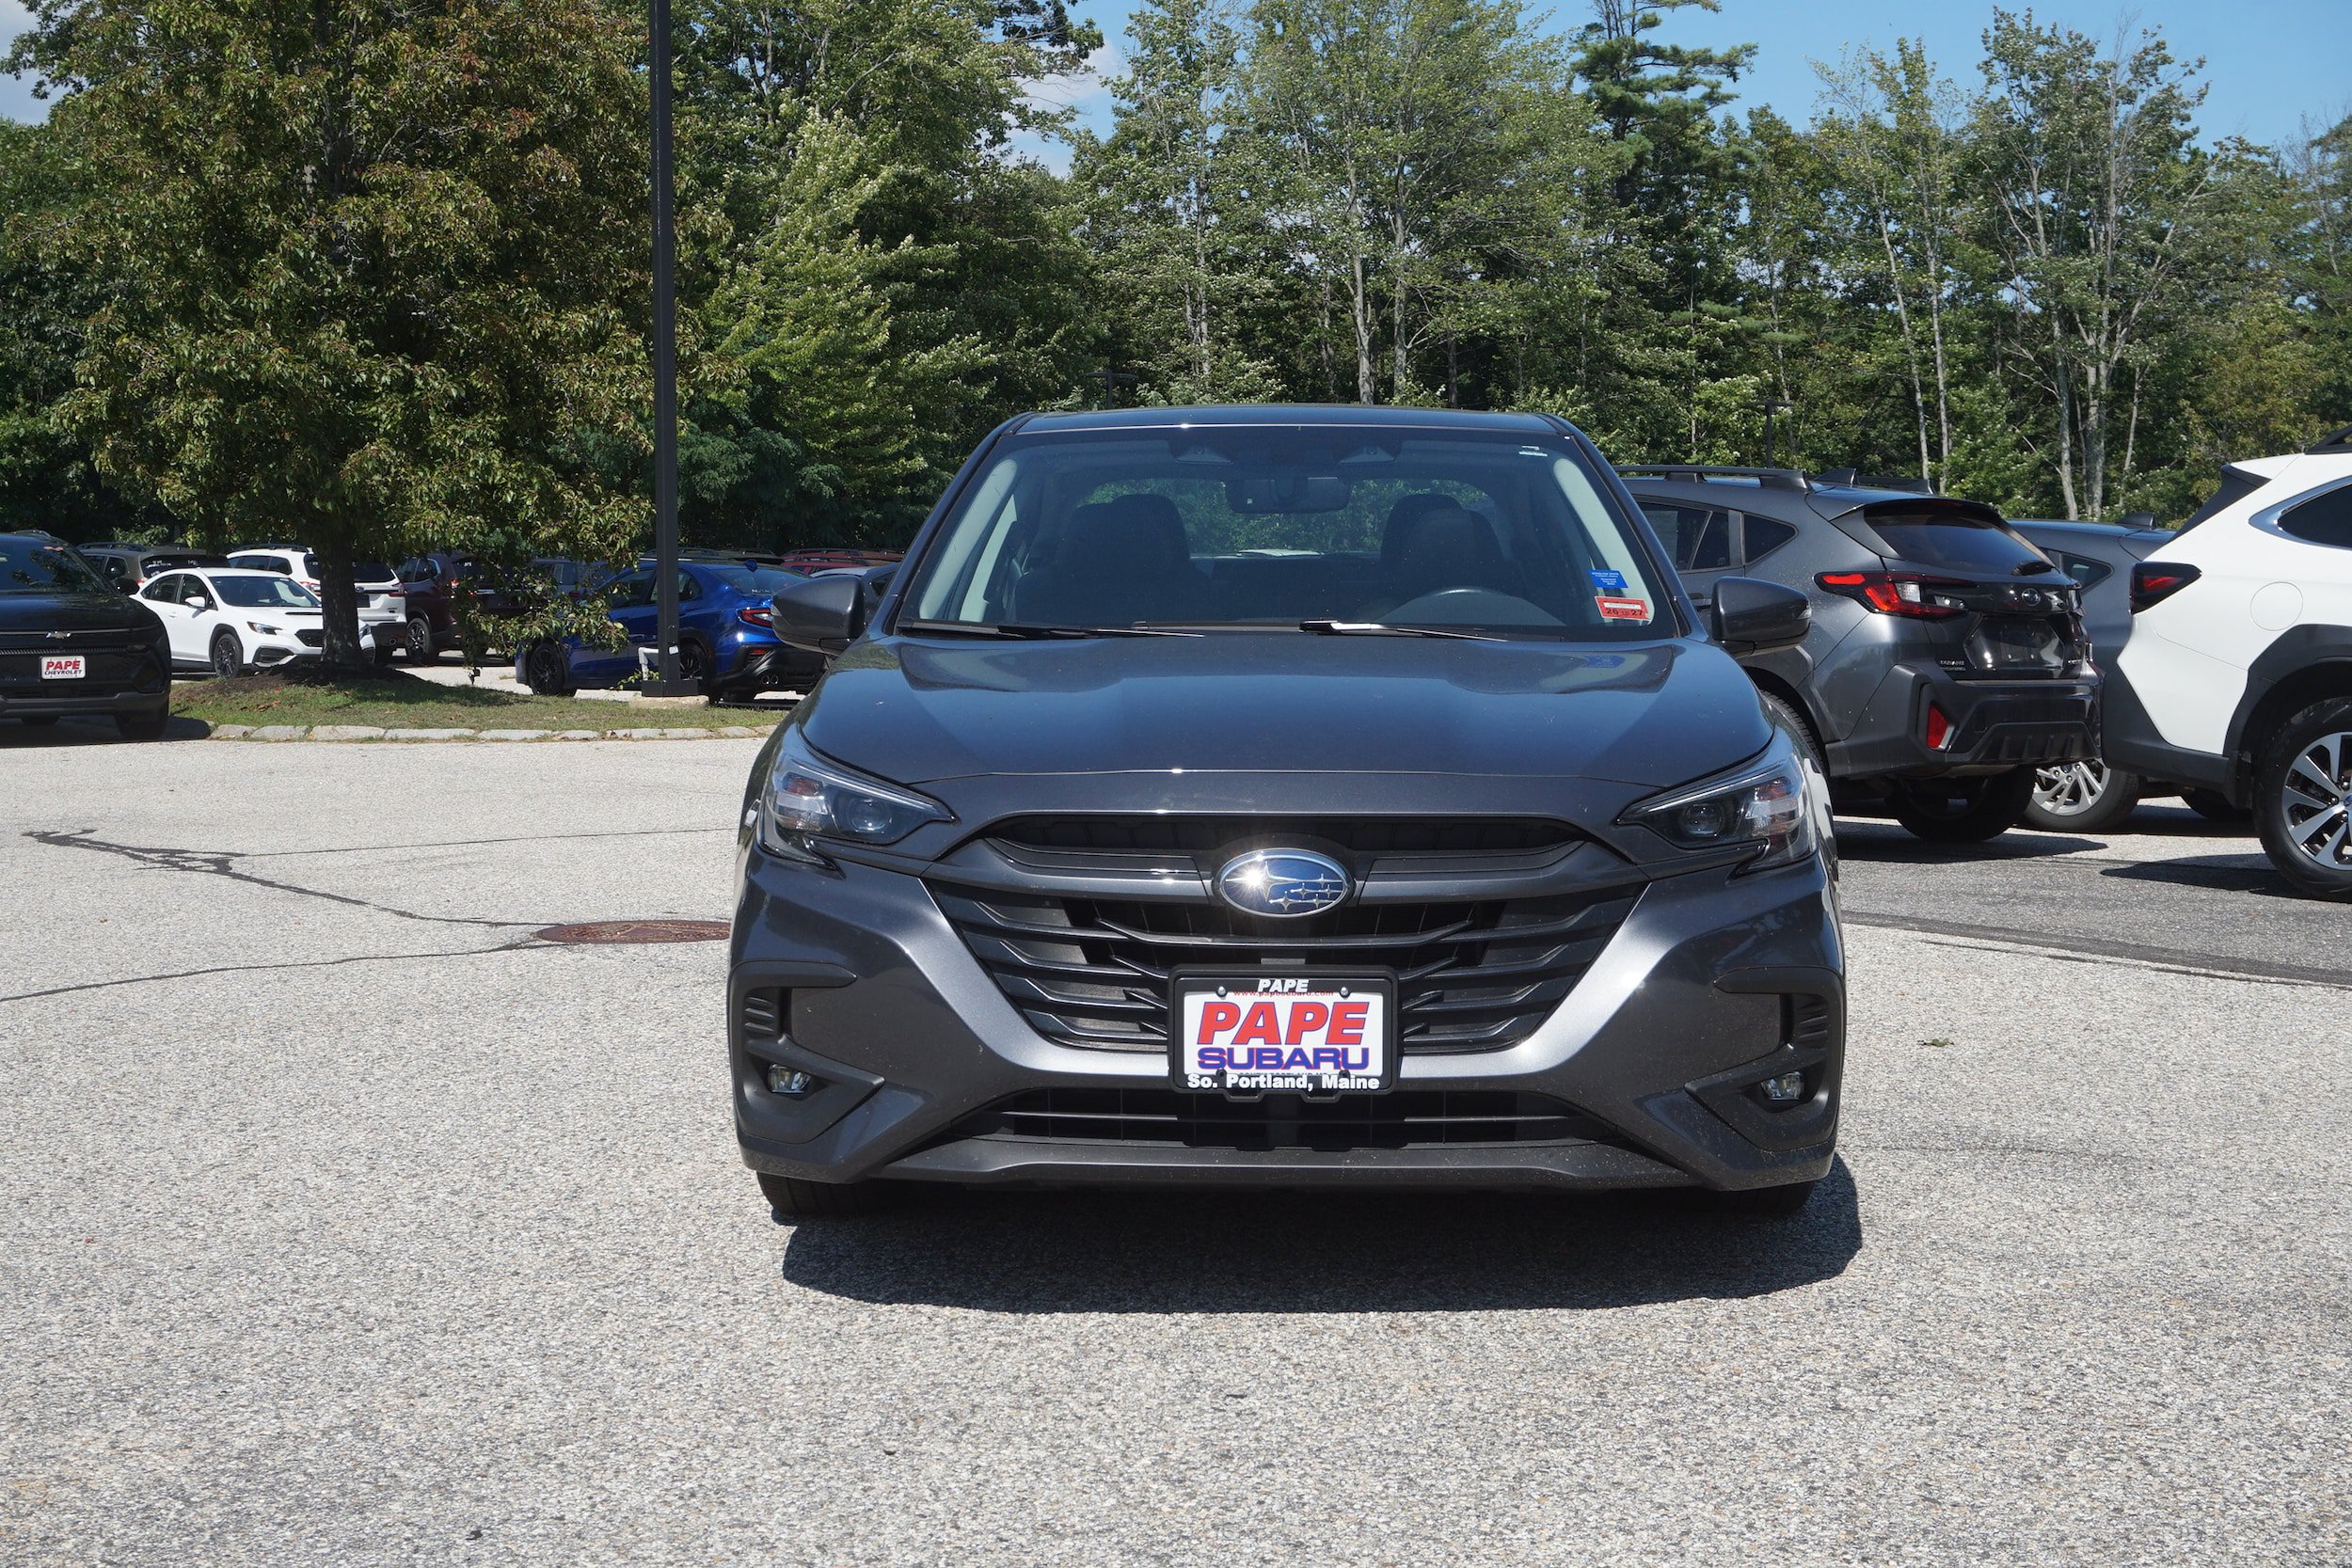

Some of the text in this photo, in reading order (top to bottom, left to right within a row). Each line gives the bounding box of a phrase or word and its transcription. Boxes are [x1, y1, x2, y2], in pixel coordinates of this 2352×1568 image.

[46, 660, 81, 670] PAPE
[1257, 979, 1309, 992] PAPE
[1197, 1001, 1370, 1045] PAPE
[1197, 1047, 1370, 1070] SUBARU
[1187, 1073, 1380, 1092] So. Portland, Maine
